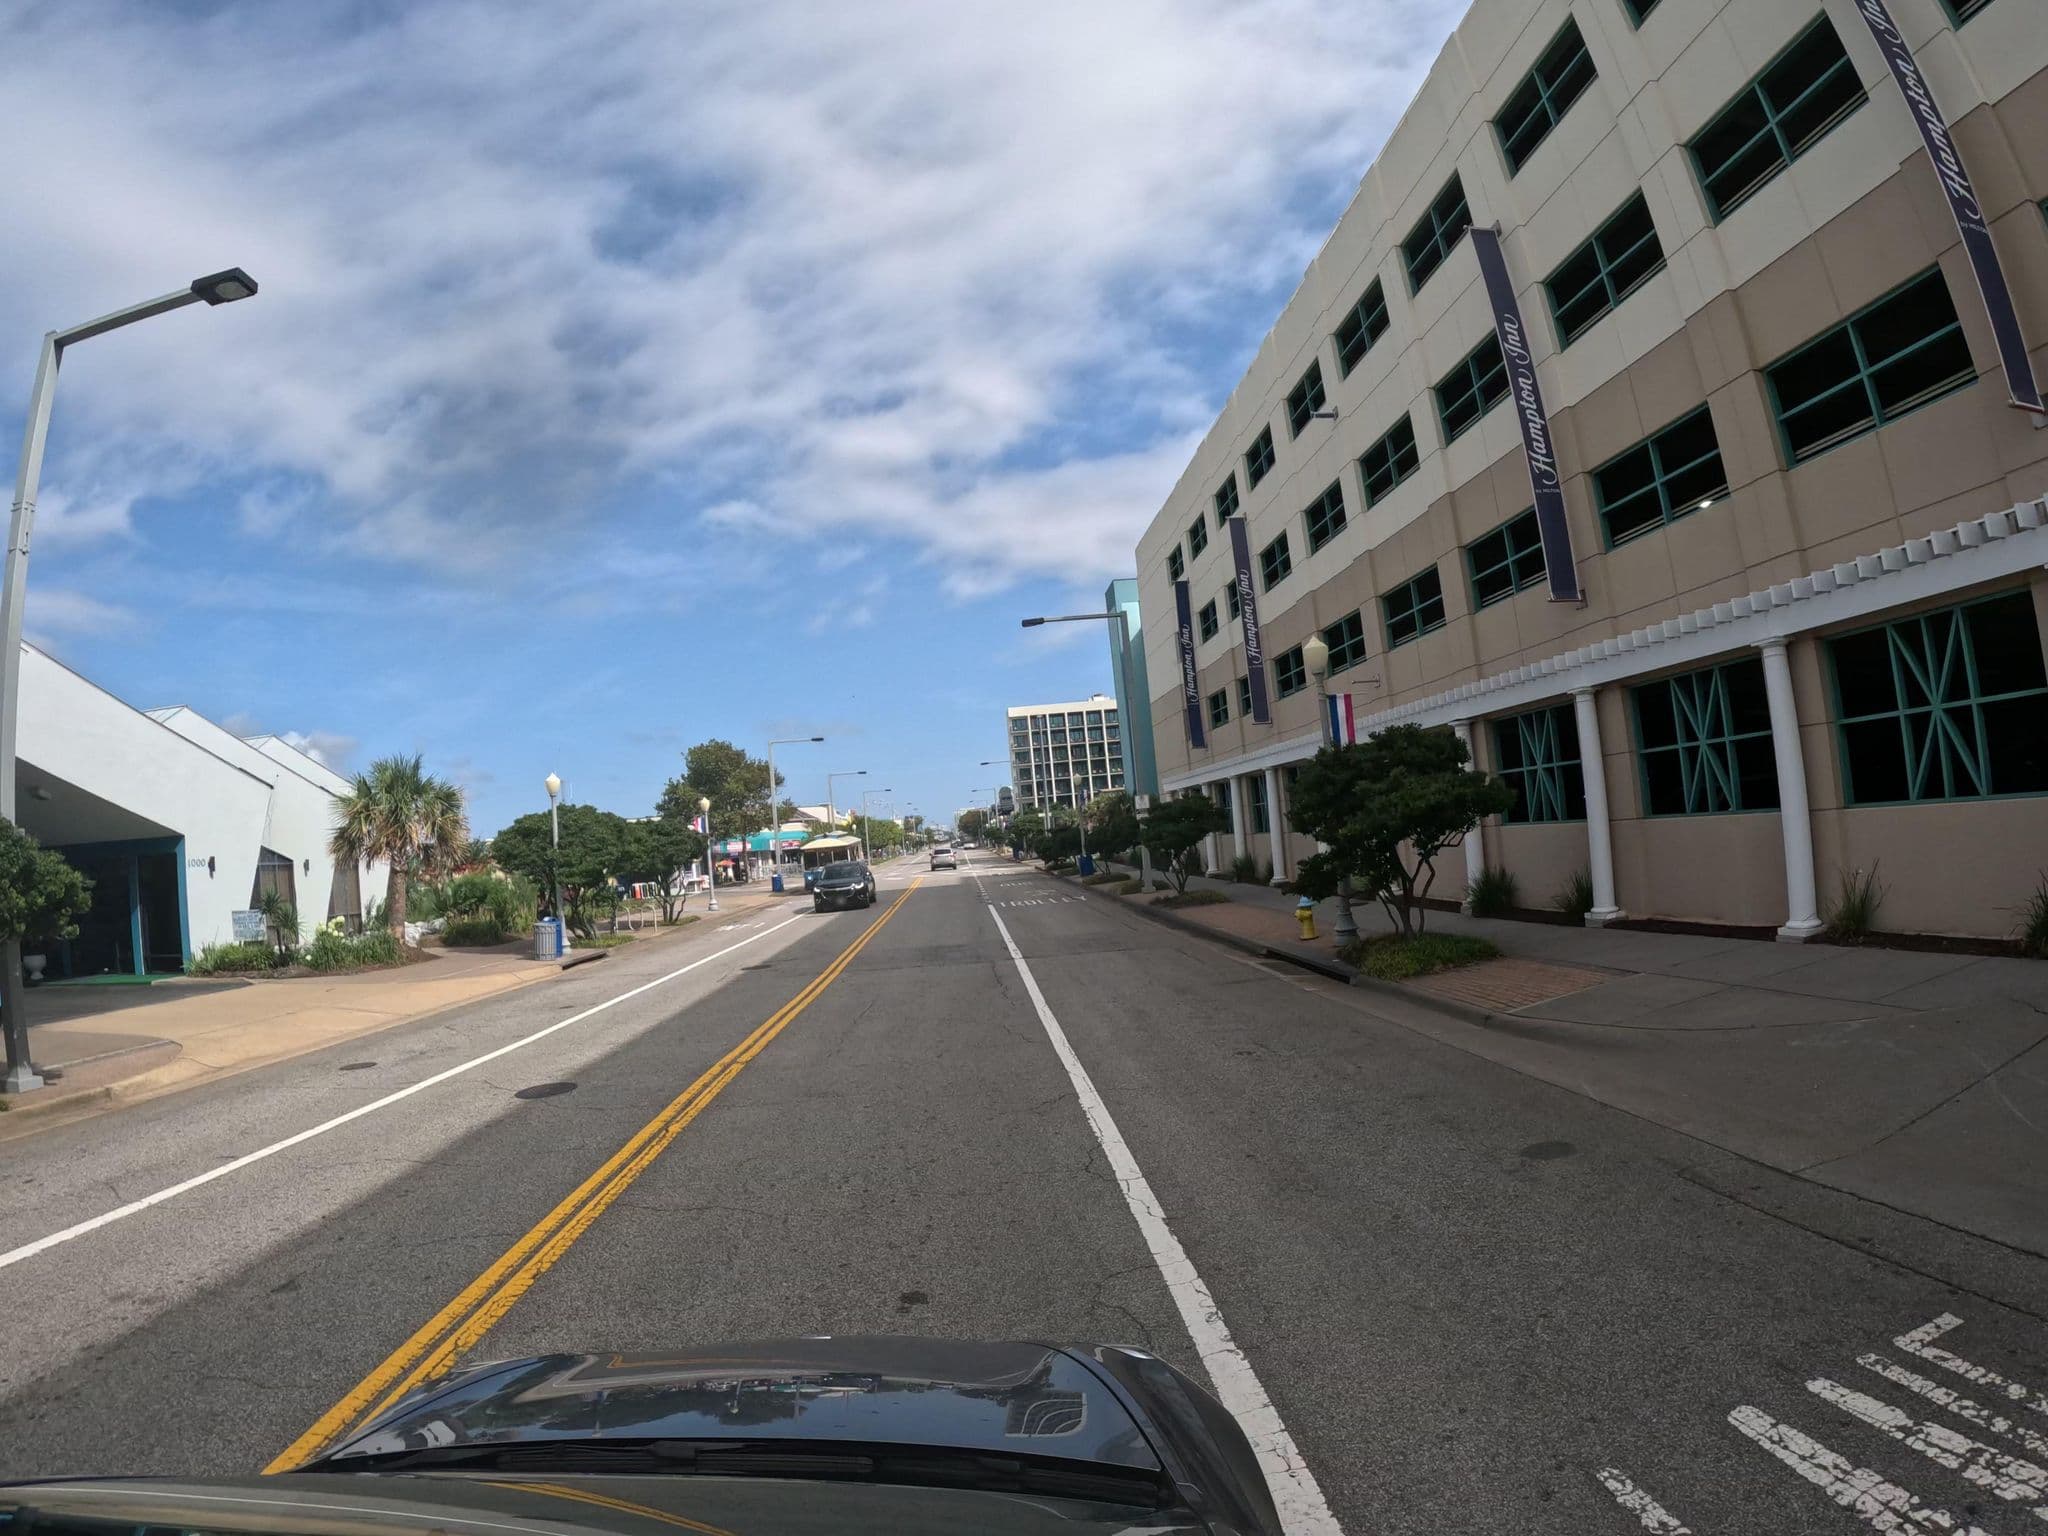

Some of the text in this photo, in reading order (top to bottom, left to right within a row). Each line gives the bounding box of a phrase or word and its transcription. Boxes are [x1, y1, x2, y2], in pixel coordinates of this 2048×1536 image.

[1892, 48, 1981, 219] Hampton
[1503, 313, 1558, 485] Hampton Inn
[1238, 569, 1254, 599] Inn
[1181, 624, 1200, 703] Hampton Inn
[1243, 600, 1262, 664] Hampton
[187, 858, 206, 868] 1000
